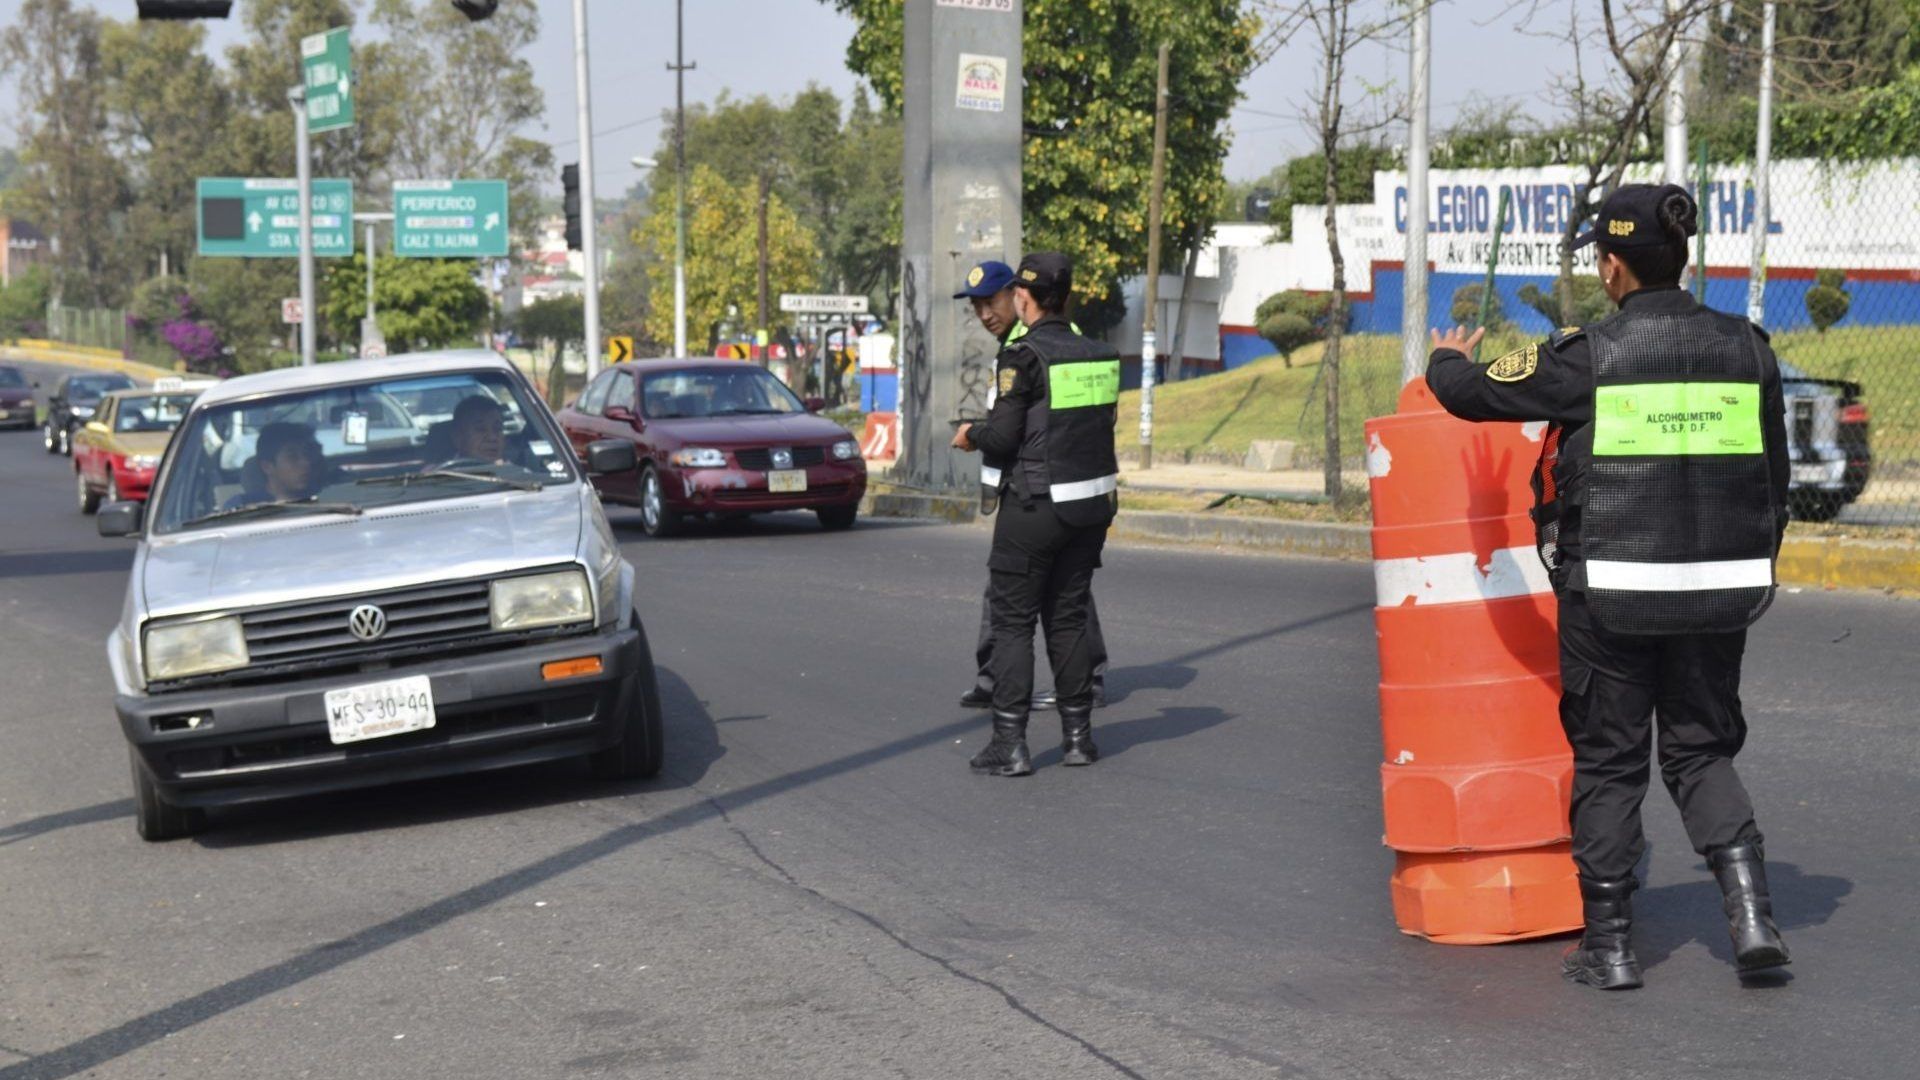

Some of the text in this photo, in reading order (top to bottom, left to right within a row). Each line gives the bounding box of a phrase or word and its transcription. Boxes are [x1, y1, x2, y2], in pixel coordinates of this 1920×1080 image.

[282, 195, 327, 210] COCO
[401, 196, 476, 211] PERIFERICO
[1394, 185, 1490, 234] CEGIO
[1609, 219, 1635, 236] SSP
[294, 233, 345, 248] USULA
[1471, 242, 1563, 267] INSRGENTES
